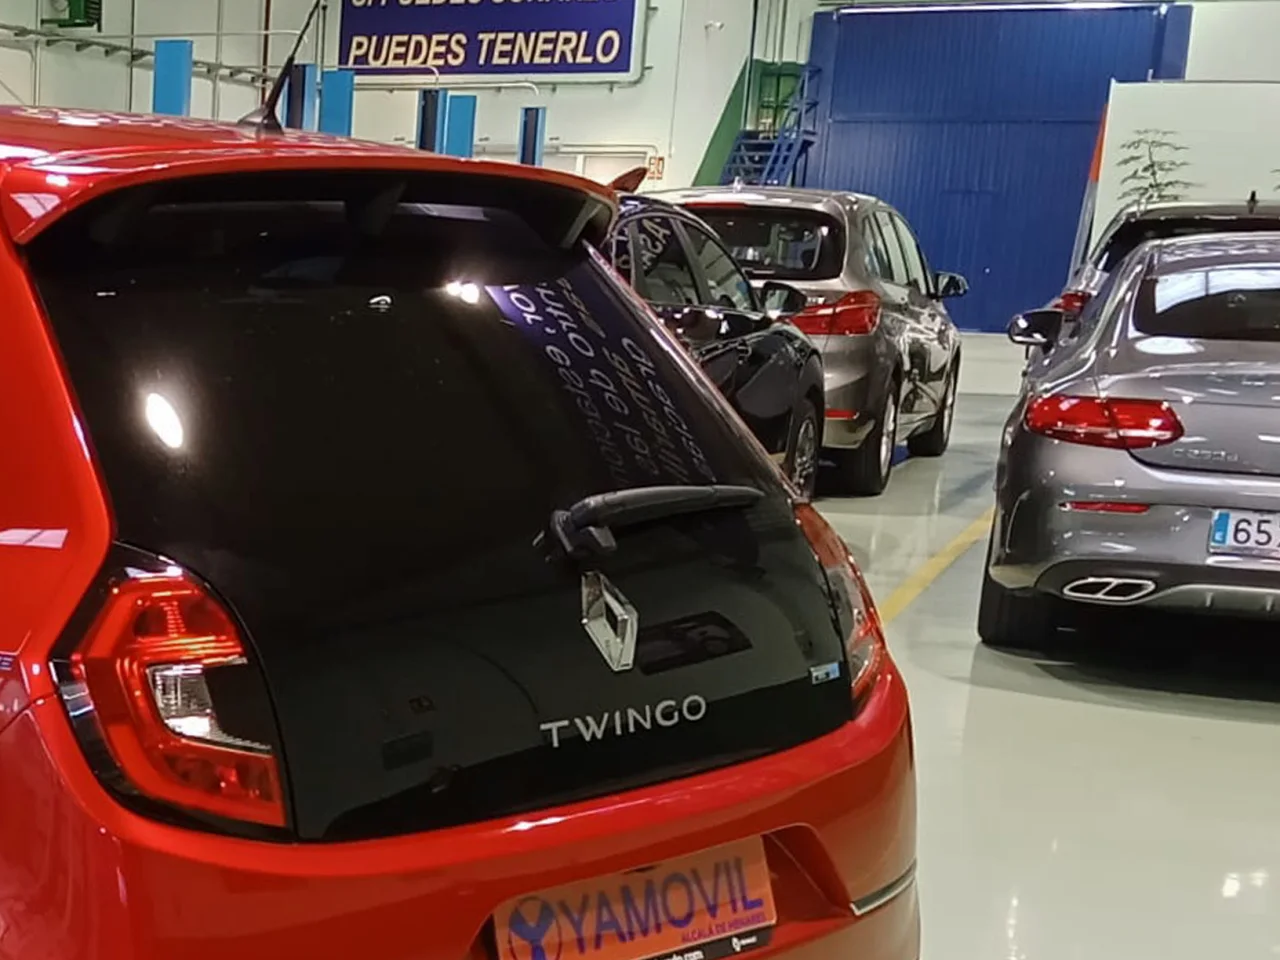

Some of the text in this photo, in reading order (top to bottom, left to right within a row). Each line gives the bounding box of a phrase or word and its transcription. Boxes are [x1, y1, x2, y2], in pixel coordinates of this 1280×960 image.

[348, 30, 621, 67] PUEDES TENERLO
[1233, 518, 1280, 546] 65
[540, 695, 708, 748] TWINGO
[552, 857, 764, 955] YAMOVIL
